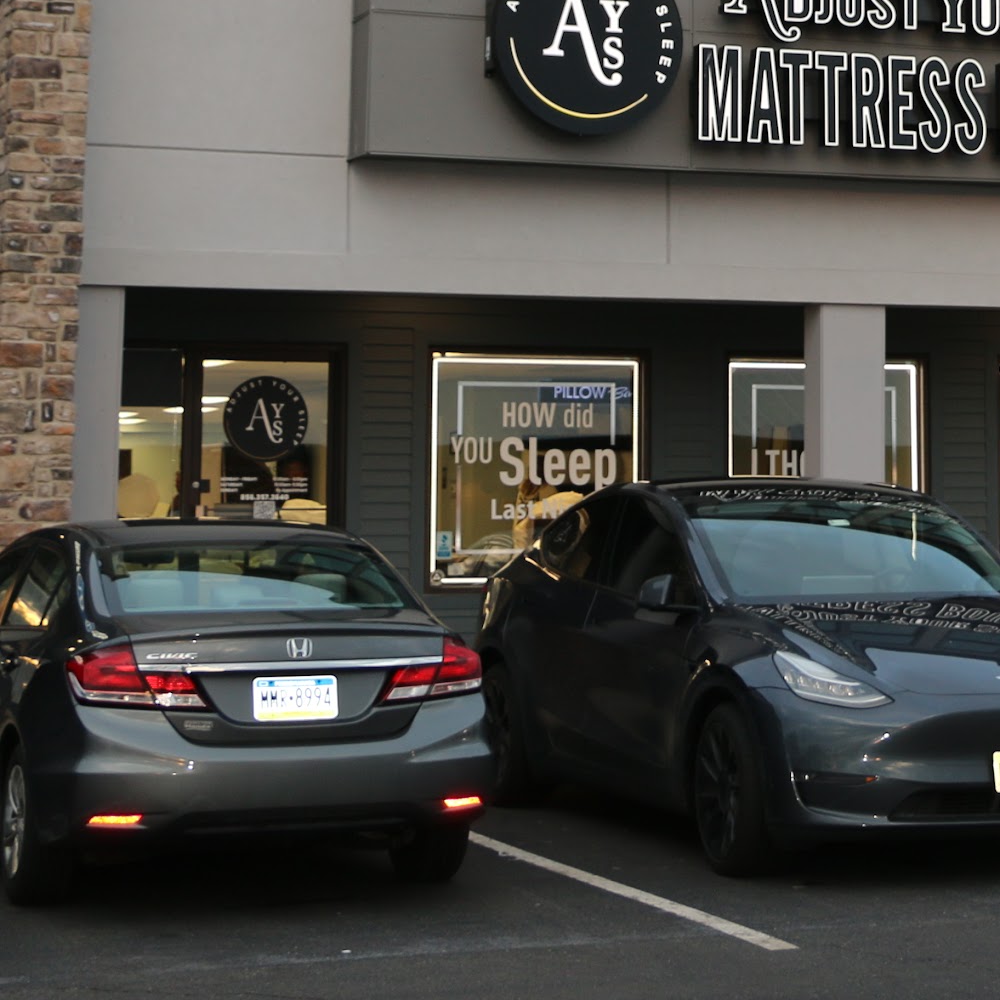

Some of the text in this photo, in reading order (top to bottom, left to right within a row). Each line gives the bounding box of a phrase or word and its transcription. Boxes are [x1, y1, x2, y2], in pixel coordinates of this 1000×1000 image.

[655, 4, 675, 84] SLEEP
[699, 43, 987, 155] MATTRESS
[226, 380, 262, 413] ADJUST
[272, 381, 299, 402] YOUR
[553, 386, 606, 399] PILLOW
[502, 402, 593, 428] HOW did
[451, 437, 617, 491] YOU Sleep
[490, 499, 536, 520] Last
